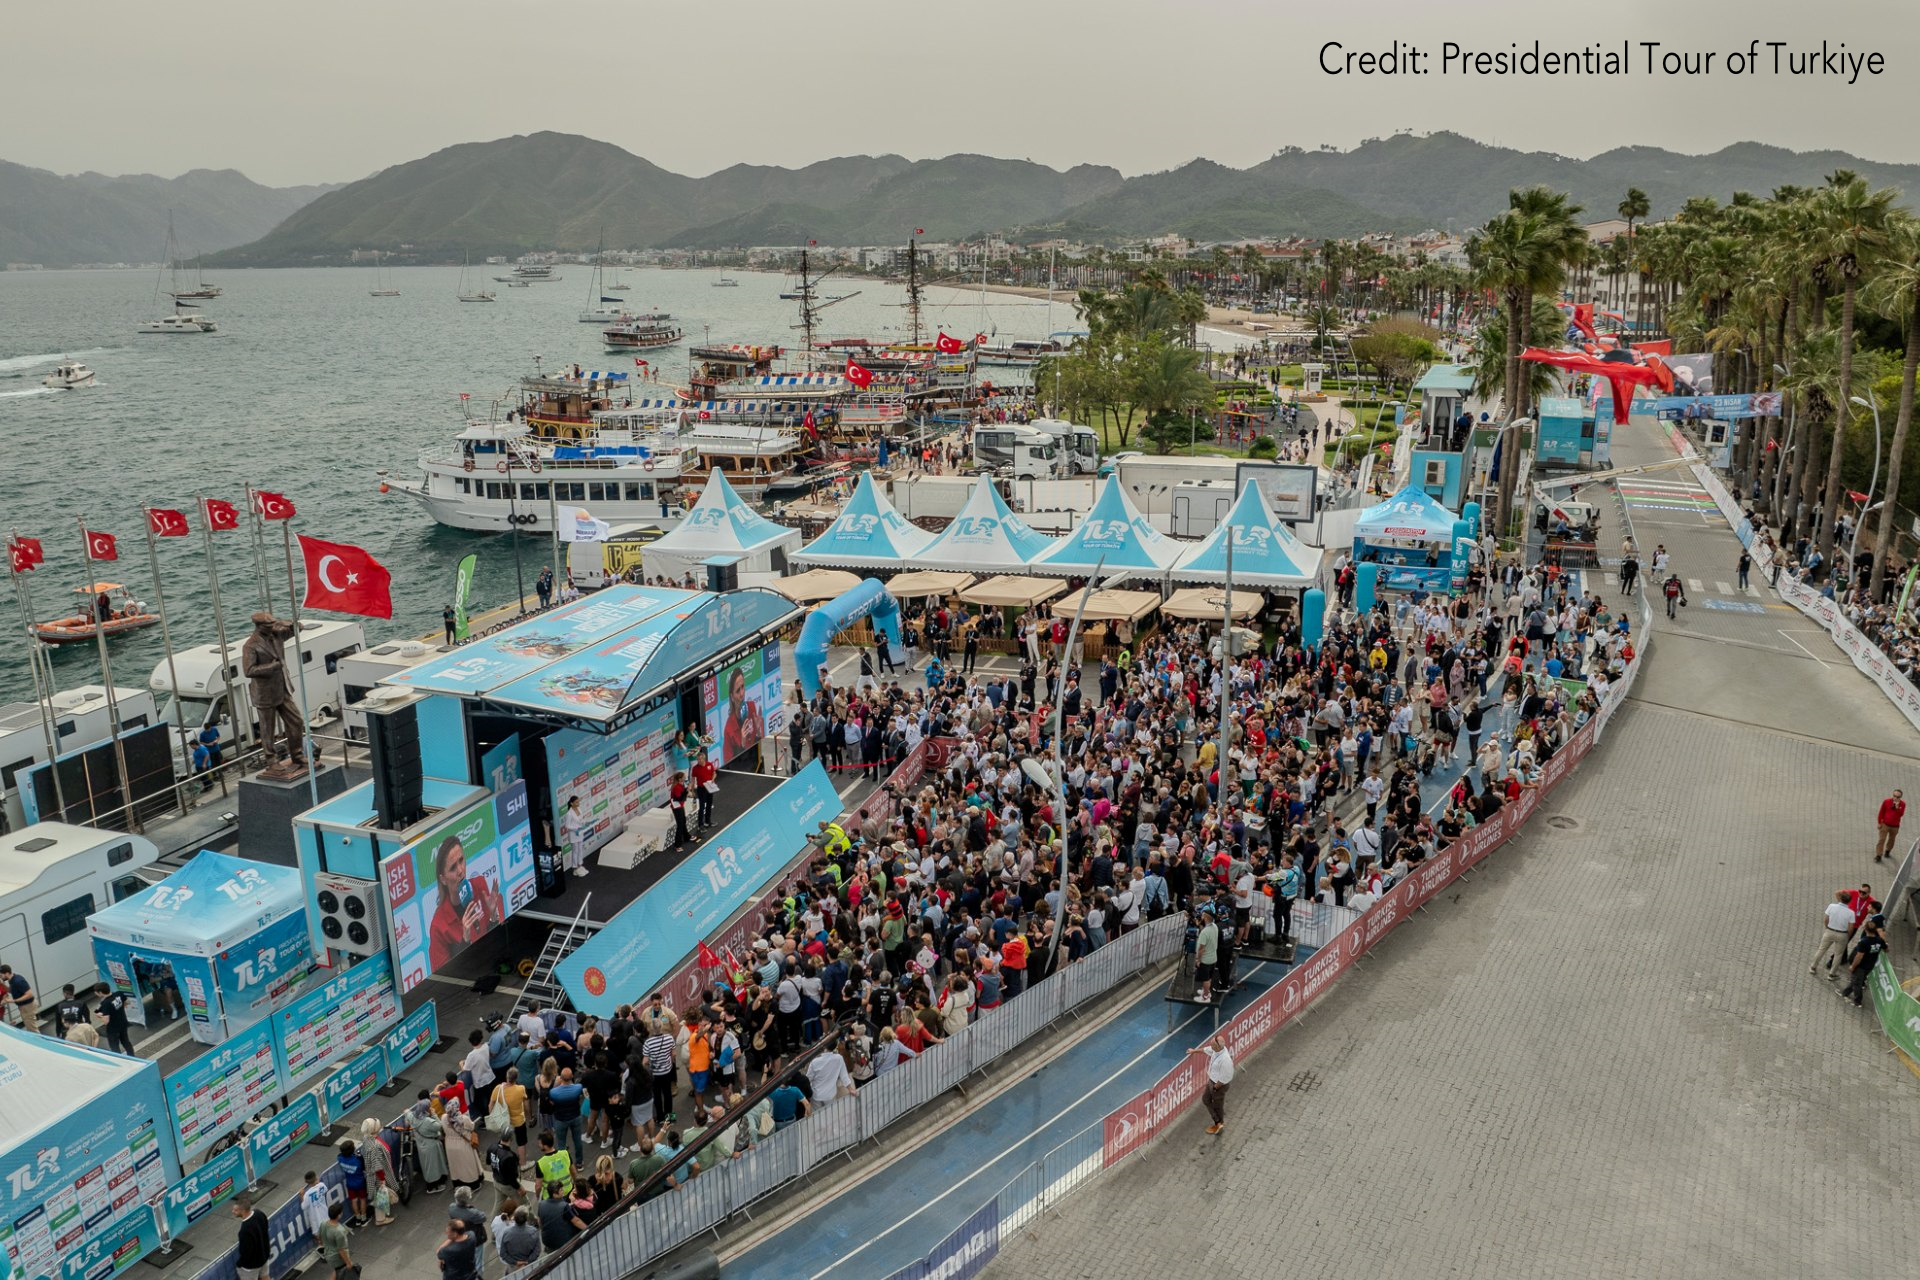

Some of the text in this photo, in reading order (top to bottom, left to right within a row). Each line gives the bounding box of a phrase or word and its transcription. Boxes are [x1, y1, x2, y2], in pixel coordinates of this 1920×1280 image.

[1472, 828, 1502, 857] AIRLINES
[1475, 817, 1503, 844] TURKISH
[1420, 865, 1451, 897] AIRLINES
[1421, 853, 1452, 884] TURKISH
[1365, 910, 1396, 944] AIRLINES
[233, 947, 278, 992] TUR
[1302, 961, 1340, 1001] AIRLINES
[1304, 944, 1340, 984] TURKISH
[1228, 1000, 1272, 1044] TURKISH
[1228, 1015, 1272, 1061] AIRLINES
[1143, 1081, 1193, 1132] AIRLINES
[1144, 1065, 1193, 1115] TURKISH
[253, 1120, 281, 1150] TUR
[6, 1147, 61, 1200] TUR
[168, 1177, 199, 1208] TUR
[66, 1240, 101, 1276] TUR
